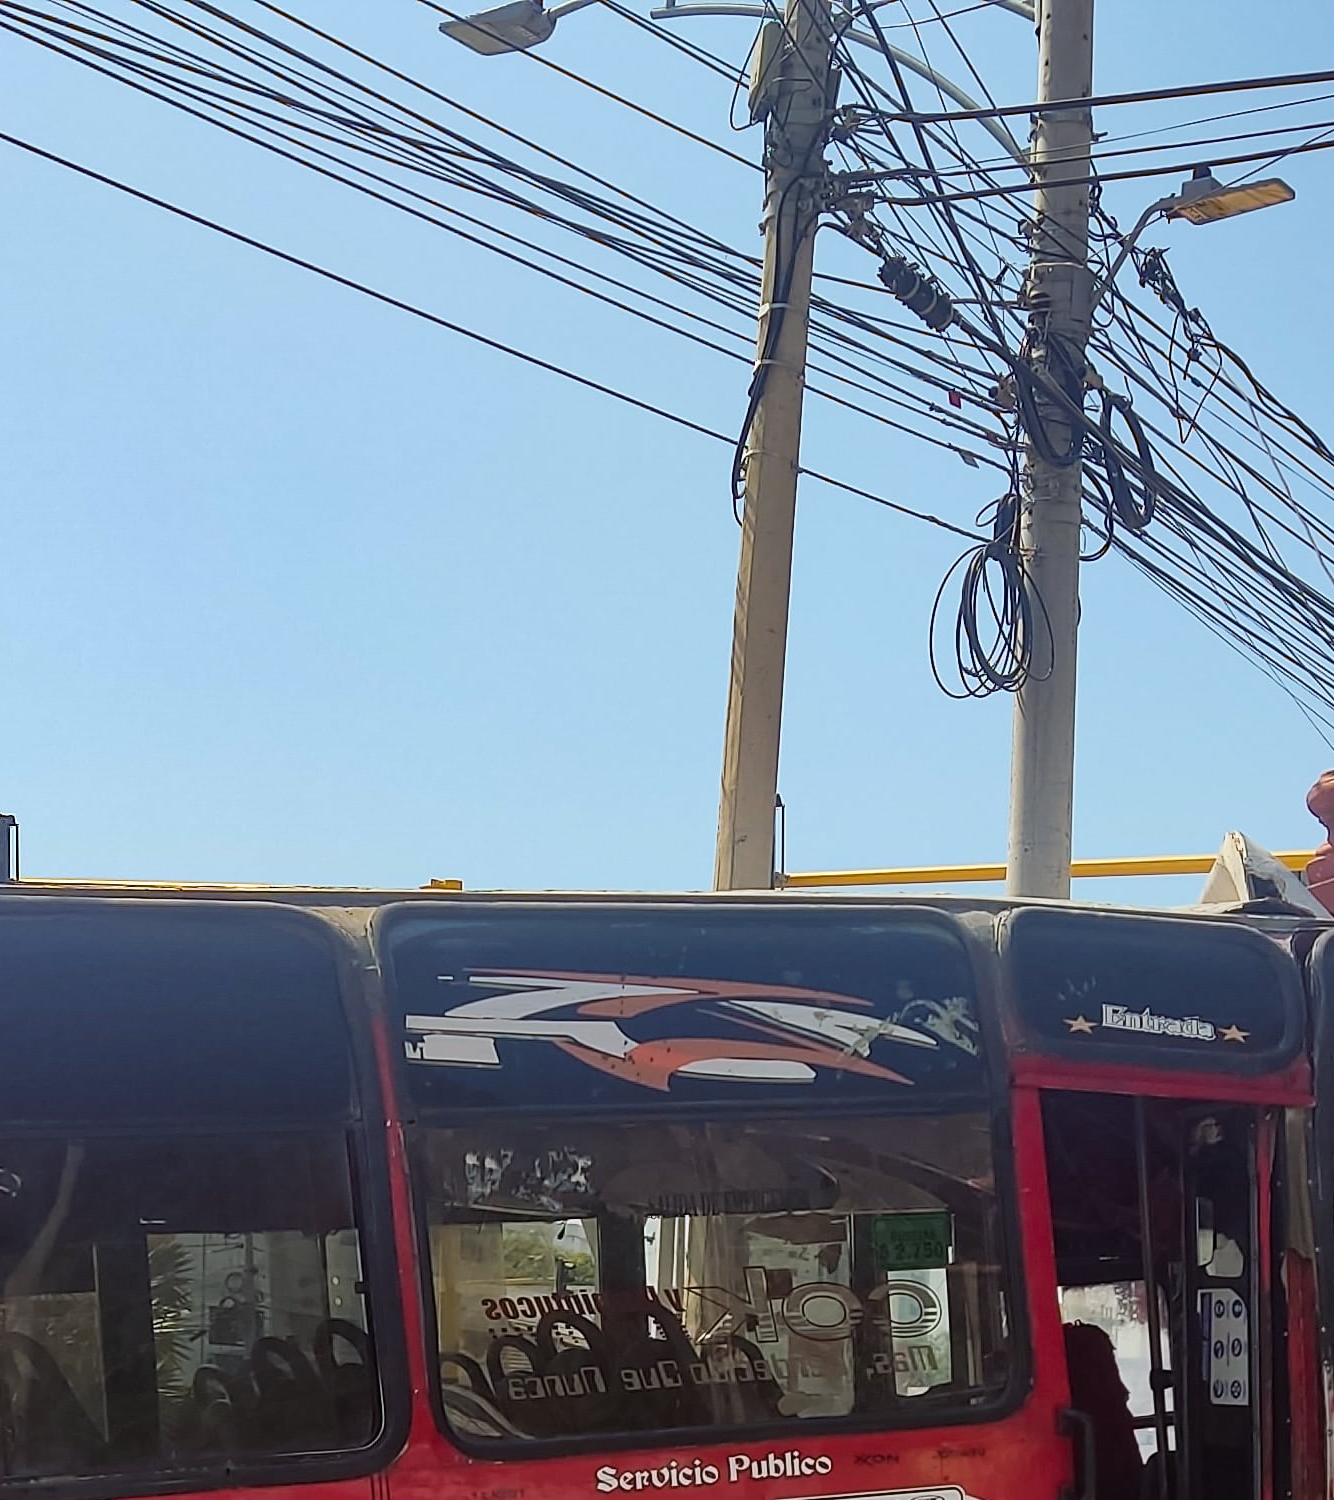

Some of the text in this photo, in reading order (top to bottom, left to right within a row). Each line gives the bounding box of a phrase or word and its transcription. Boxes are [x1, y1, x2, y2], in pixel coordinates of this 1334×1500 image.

[1101, 1002, 1217, 1042] Entrada
[596, 1450, 833, 1493] Servicio Publico
